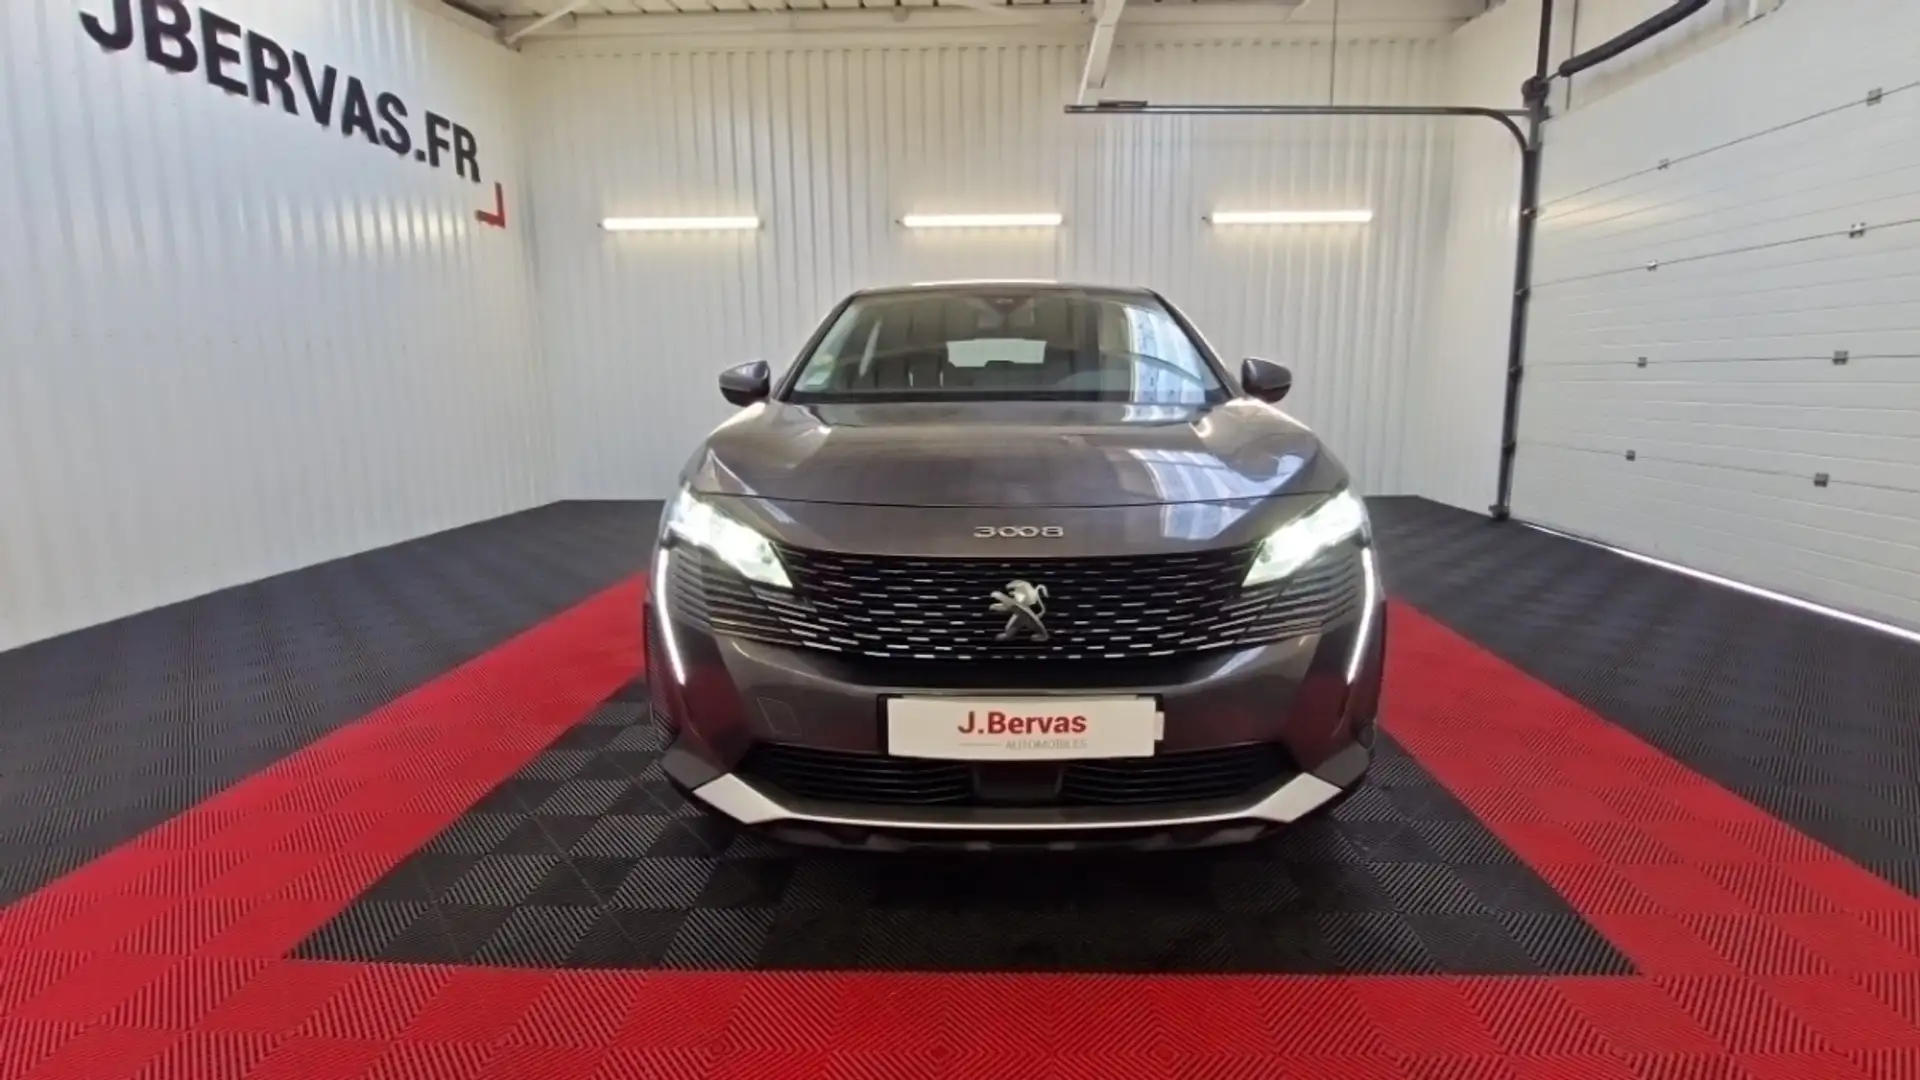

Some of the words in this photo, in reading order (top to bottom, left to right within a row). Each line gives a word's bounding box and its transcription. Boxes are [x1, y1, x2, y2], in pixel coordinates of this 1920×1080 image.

[973, 525, 1064, 538] 3008
[957, 710, 1087, 734] J.Bervas
[1005, 739, 1087, 750] AUTOMOBILES
